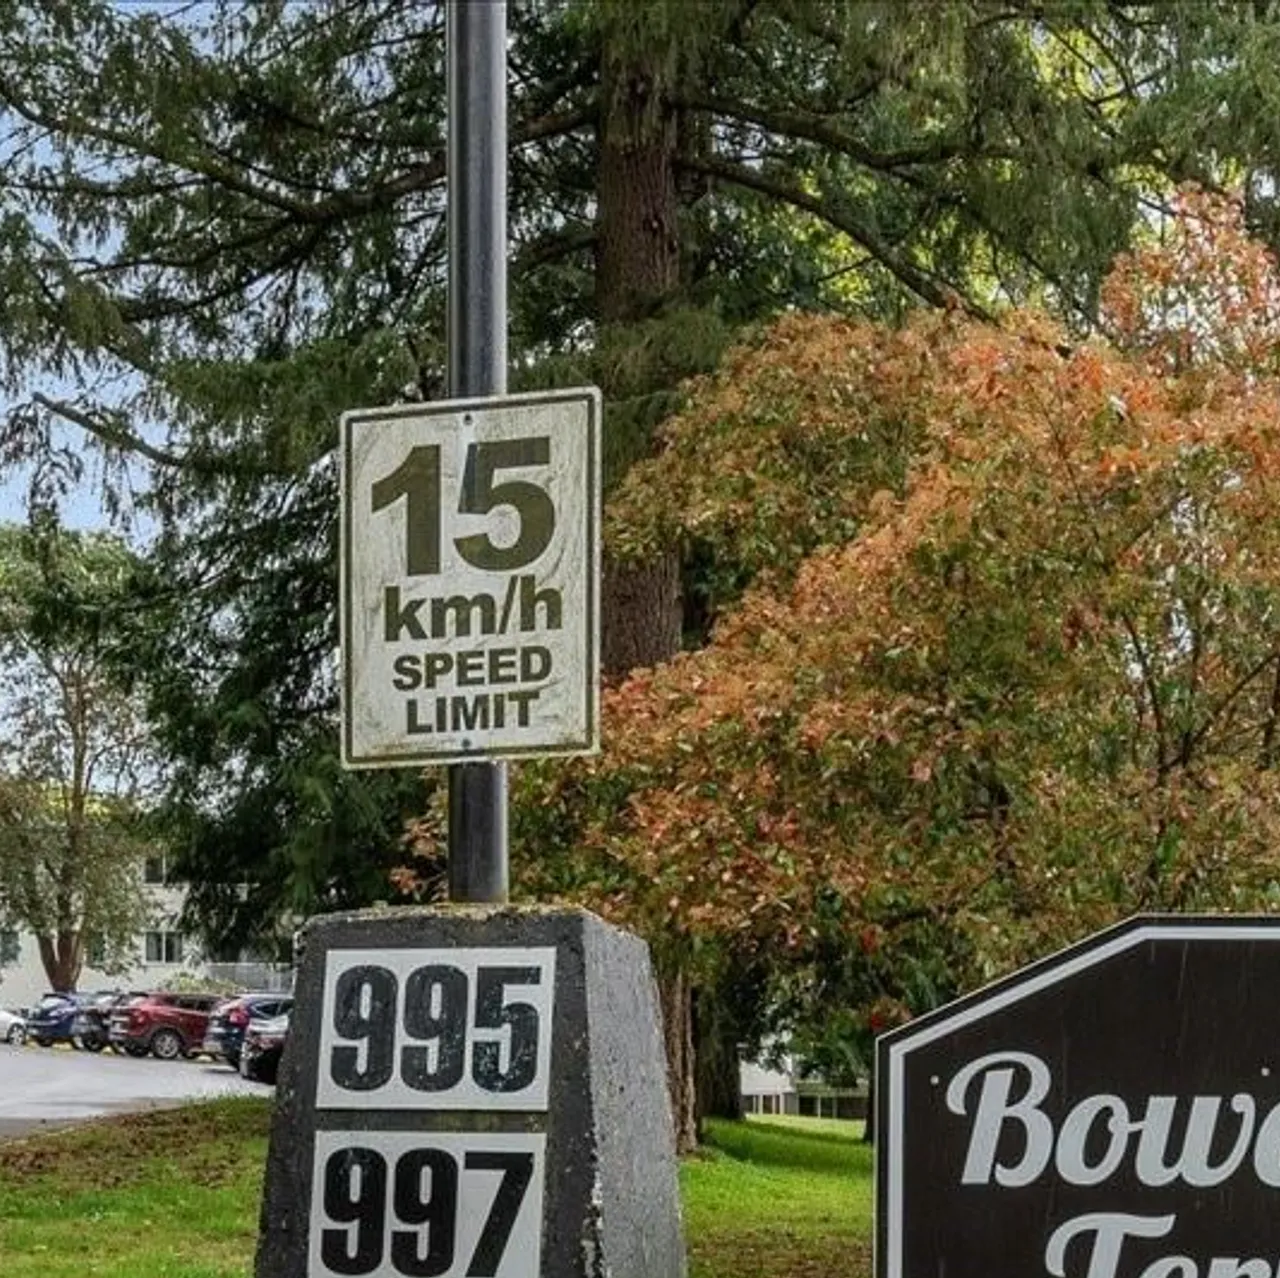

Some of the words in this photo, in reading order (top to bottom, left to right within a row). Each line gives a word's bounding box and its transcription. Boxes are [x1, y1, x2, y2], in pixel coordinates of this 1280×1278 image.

[371, 436, 556, 577] 15
[384, 574, 562, 642] km/h
[393, 645, 552, 692] SPEED
[406, 693, 540, 735] LIMIT
[331, 964, 542, 1093] 995
[321, 1146, 534, 1278] 997
